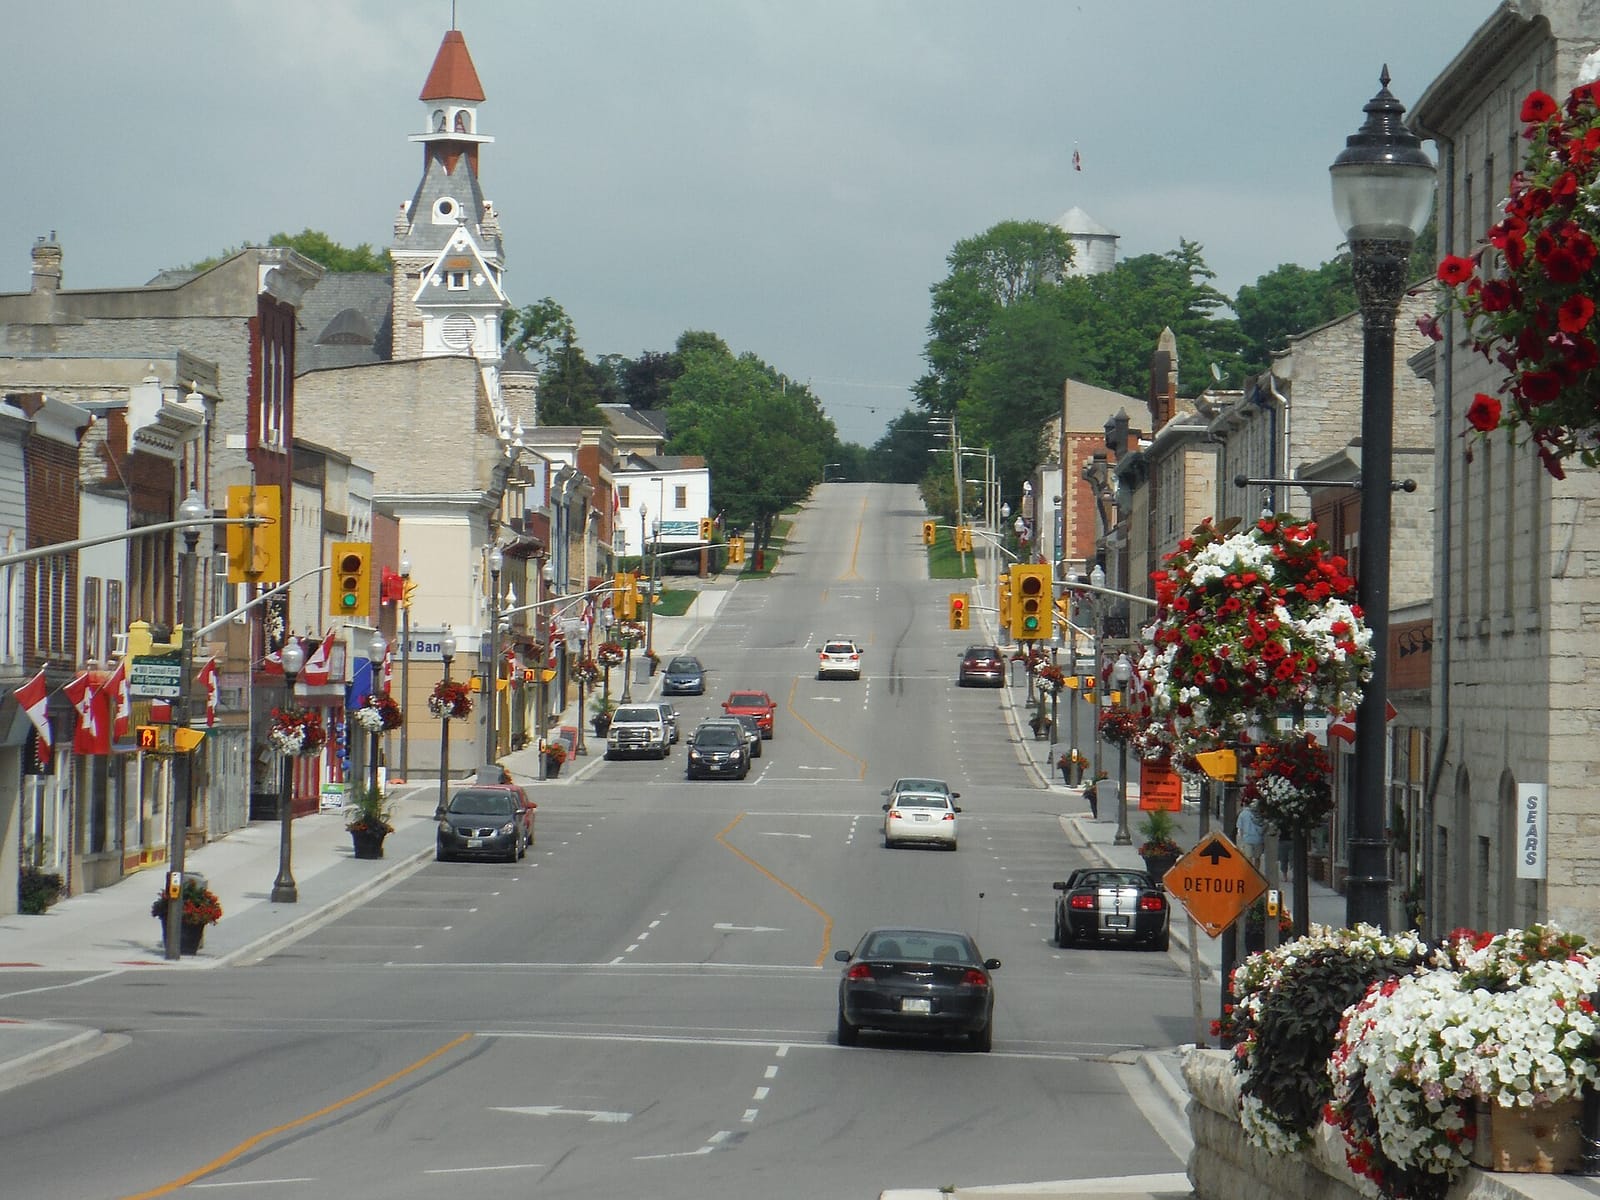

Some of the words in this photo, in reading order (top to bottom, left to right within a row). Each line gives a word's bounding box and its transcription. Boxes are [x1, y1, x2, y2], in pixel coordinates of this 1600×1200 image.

[416, 640, 441, 653] Ban
[1524, 795, 1538, 866] SEARS
[1184, 877, 1245, 894] DETOUR
